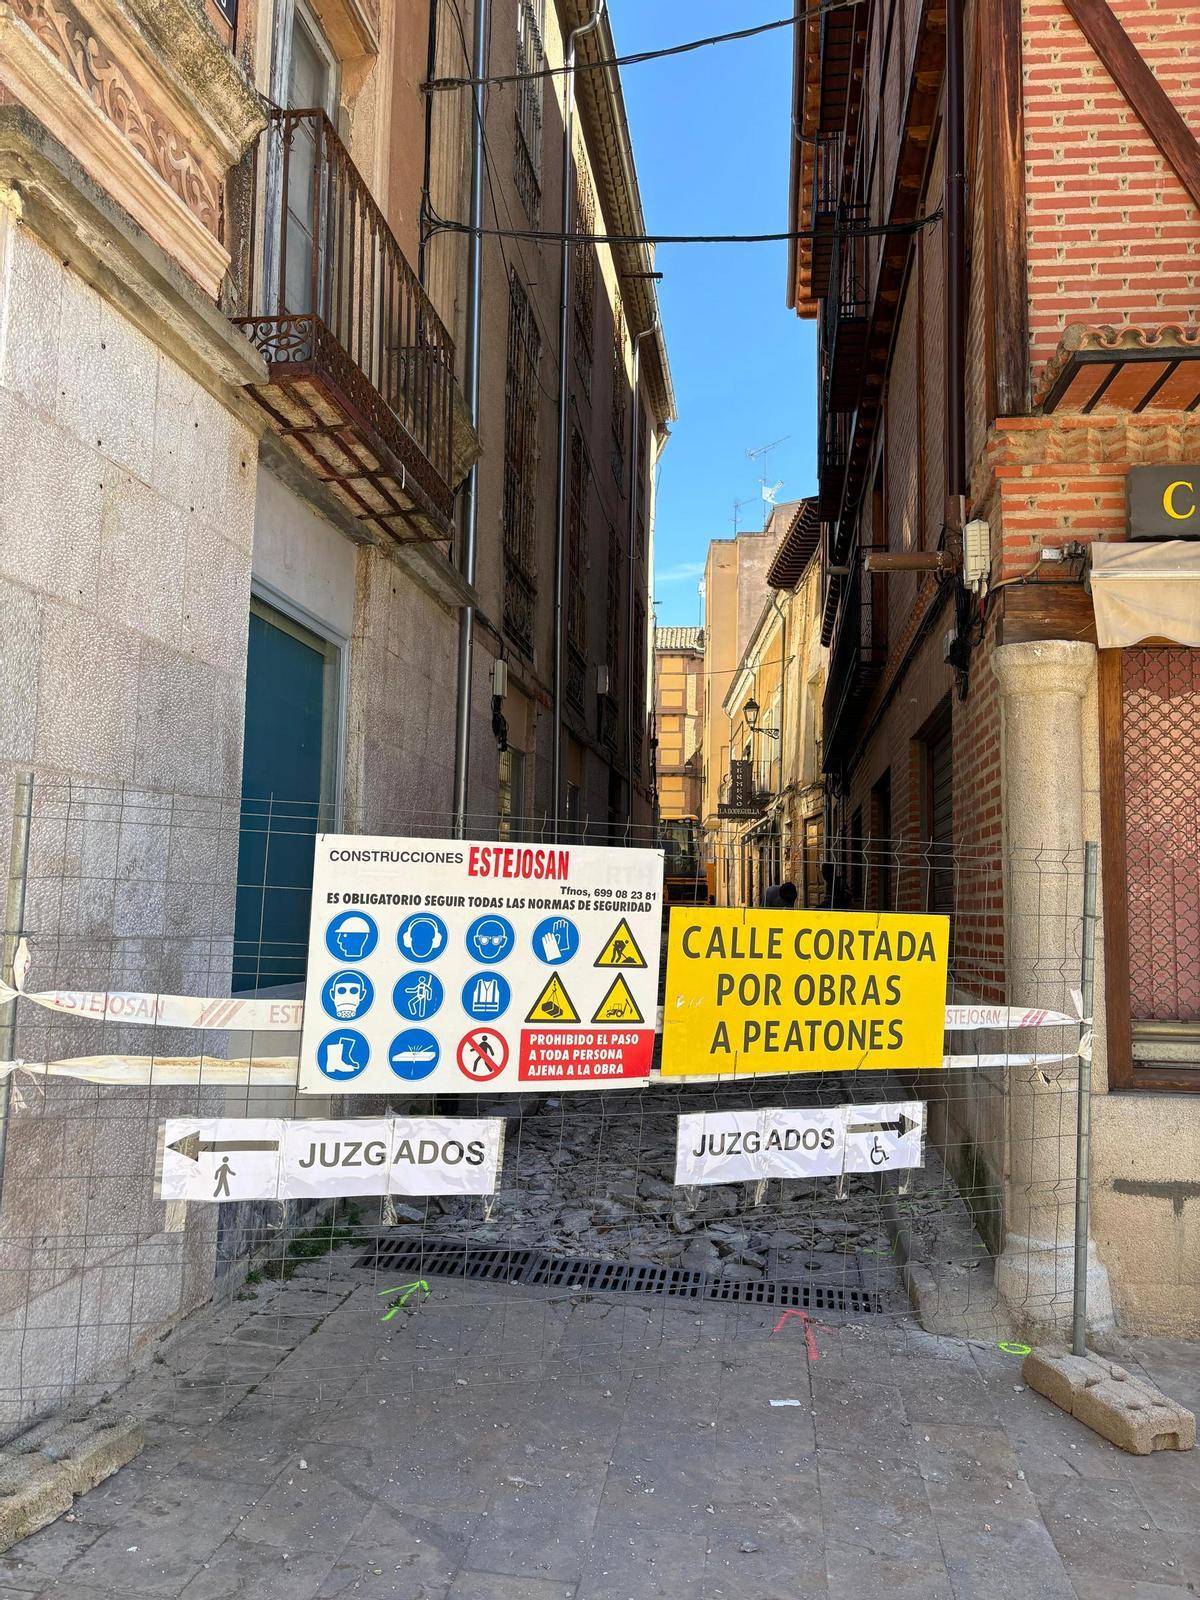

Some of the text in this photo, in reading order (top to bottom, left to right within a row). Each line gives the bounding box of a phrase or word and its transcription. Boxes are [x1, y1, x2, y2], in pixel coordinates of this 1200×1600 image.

[1162, 480, 1196, 520] C
[329, 846, 570, 881] CONSTRUCCIONES ESTEJOSAN
[326, 892, 652, 913] ES OBLIGATORIO SEGUIR TODAS LAS NORMAS DE SEGURIDAD
[594, 888, 613, 898] 699
[615, 890, 628, 899] 08
[630, 890, 643, 900] 23
[645, 891, 657, 901] 81
[682, 925, 936, 962] CALLE CORTADA
[716, 973, 901, 1007] POR OBRAS
[945, 1009, 1001, 1025] STEJOSAN
[529, 1033, 639, 1046] PROHIBIDO EL PASO
[710, 1018, 903, 1054] A PEATONES
[528, 1063, 624, 1077] AJENA A LA OBRA
[529, 1049, 623, 1061] A TODA PERSONA
[298, 1139, 485, 1169] JUZGADOS
[692, 1127, 835, 1157] JUZGADOS
